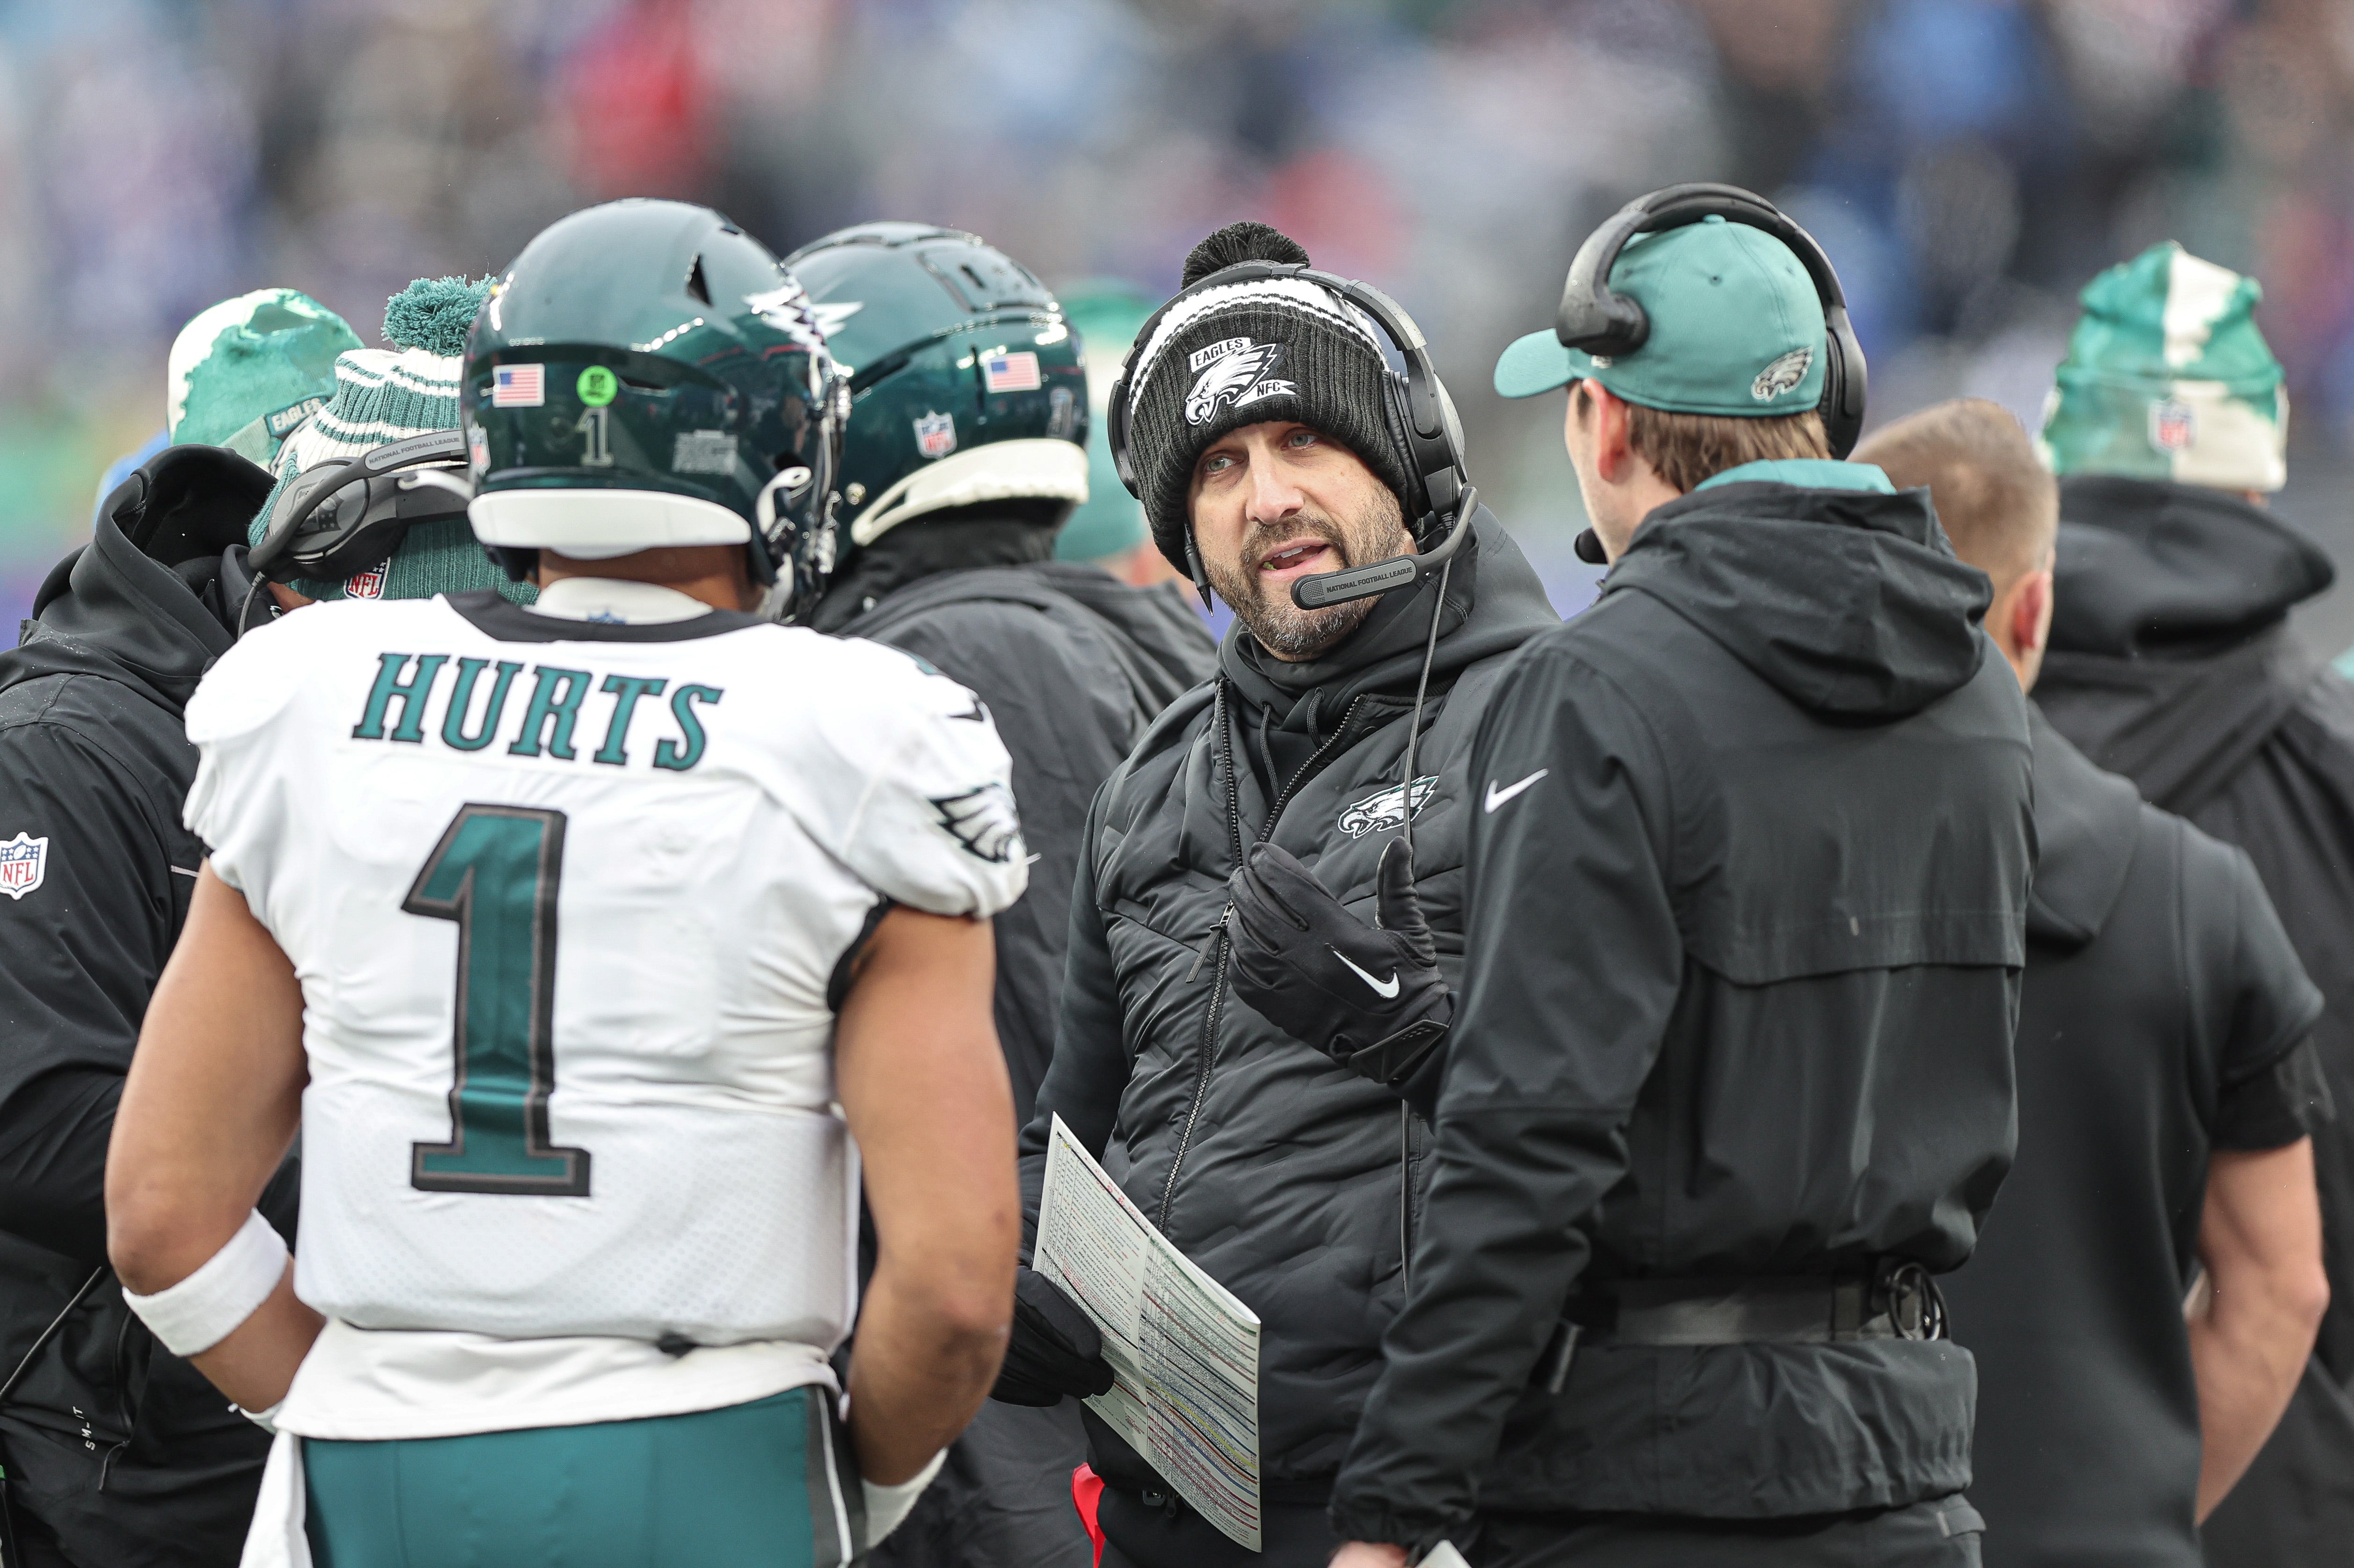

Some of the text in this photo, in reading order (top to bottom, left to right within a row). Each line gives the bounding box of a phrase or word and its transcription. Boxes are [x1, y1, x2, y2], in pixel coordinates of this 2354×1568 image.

[1196, 338, 1243, 366] EAGLES
[1257, 381, 1280, 397] NFC
[271, 398, 323, 432] EAGLES
[369, 451, 401, 464] NATIONAL
[401, 441, 434, 453] FOOTBALL
[349, 574, 379, 598] NFL
[1326, 566, 1413, 593] NATIONAL FOOTBALL LEAGUE
[351, 652, 724, 771] HURTS
[3, 861, 34, 885] NFL
[400, 802, 591, 1197] 1
